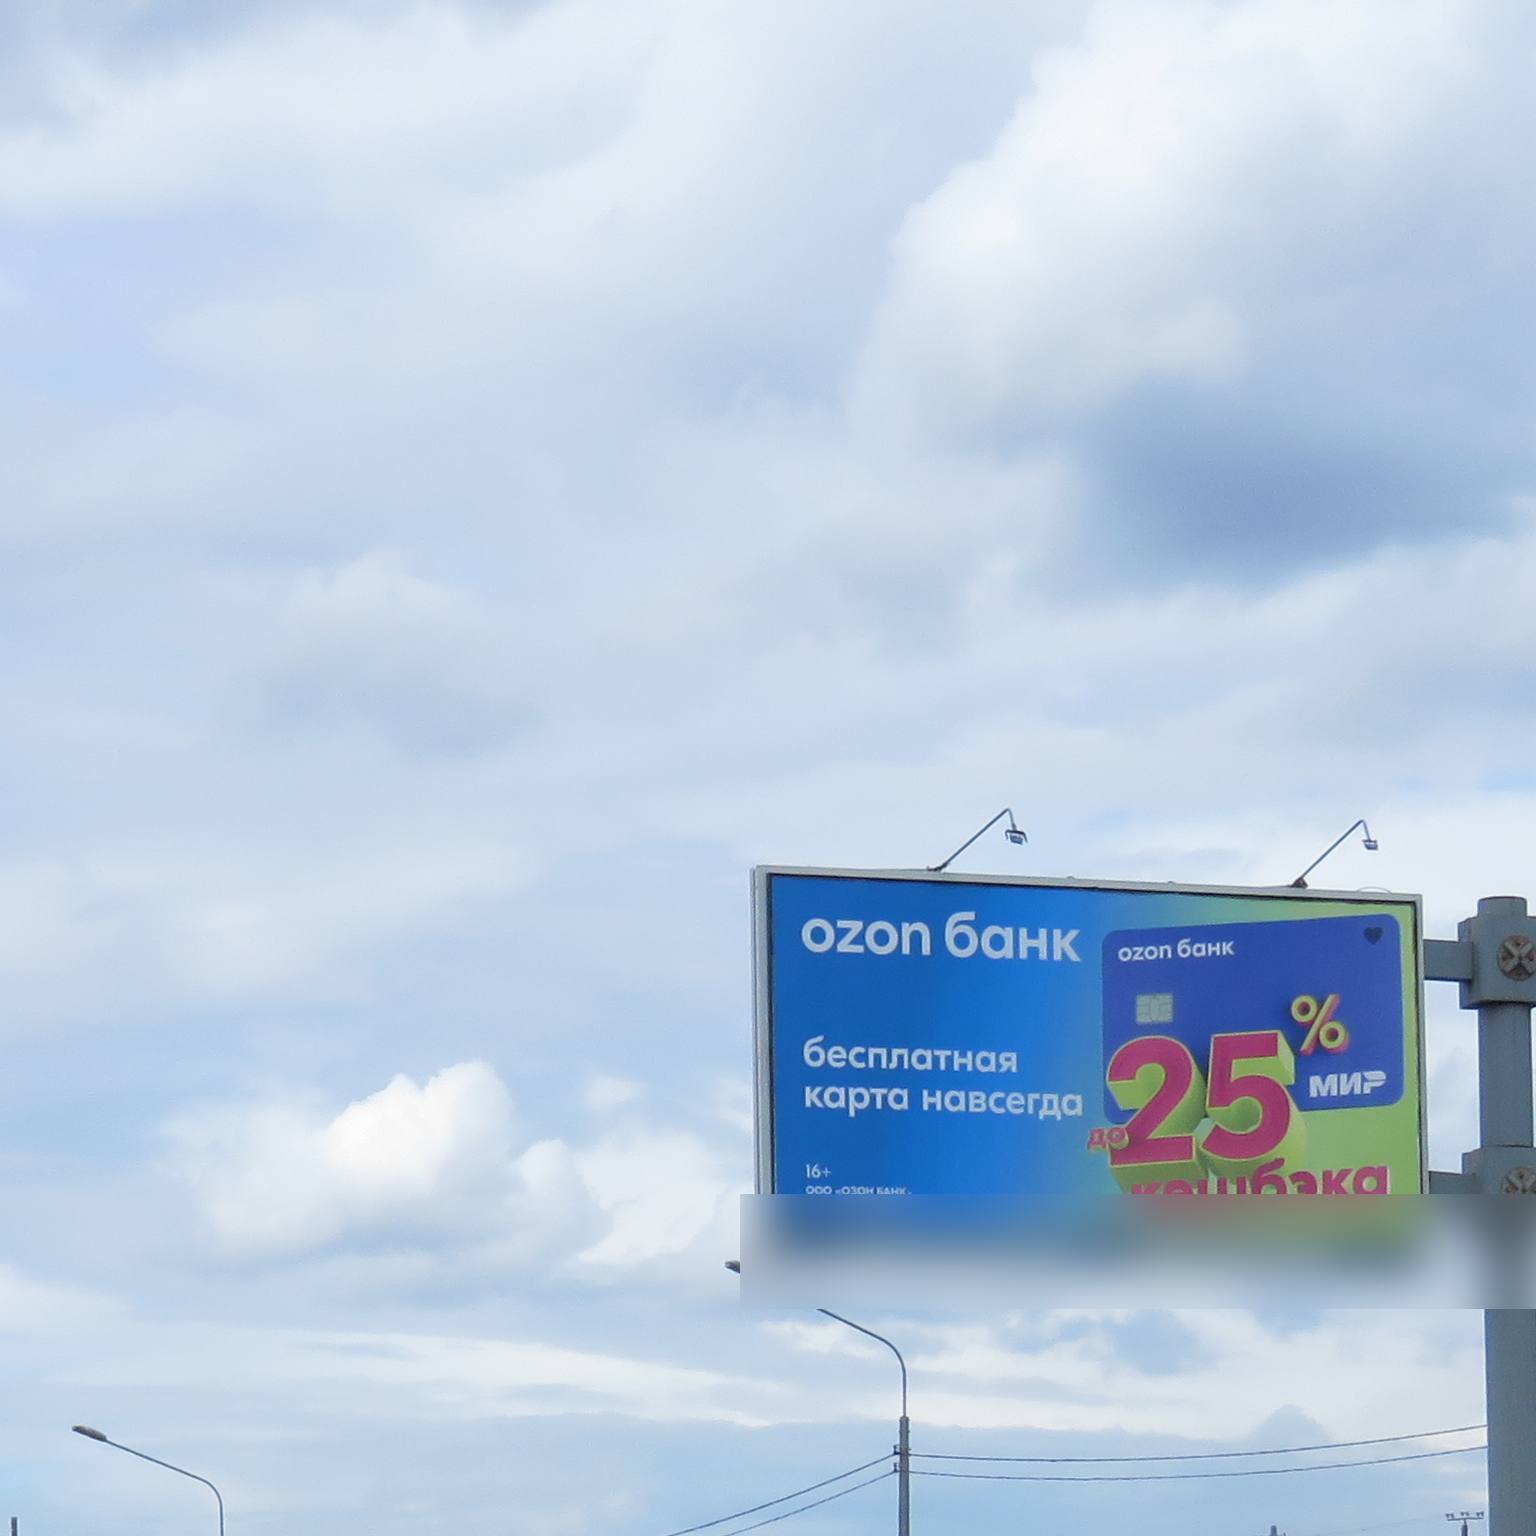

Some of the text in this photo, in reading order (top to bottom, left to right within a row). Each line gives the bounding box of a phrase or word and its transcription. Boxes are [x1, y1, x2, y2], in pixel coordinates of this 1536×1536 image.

[801, 911, 1082, 962] ozon банк
[1118, 938, 1235, 962] ozon банк
[803, 1035, 1018, 1073] бесплатная
[1309, 1070, 1387, 1098] МИР
[804, 1085, 1084, 1120] карта навсегда
[1087, 1126, 1129, 1151] до
[805, 1163, 832, 1179] 16+
